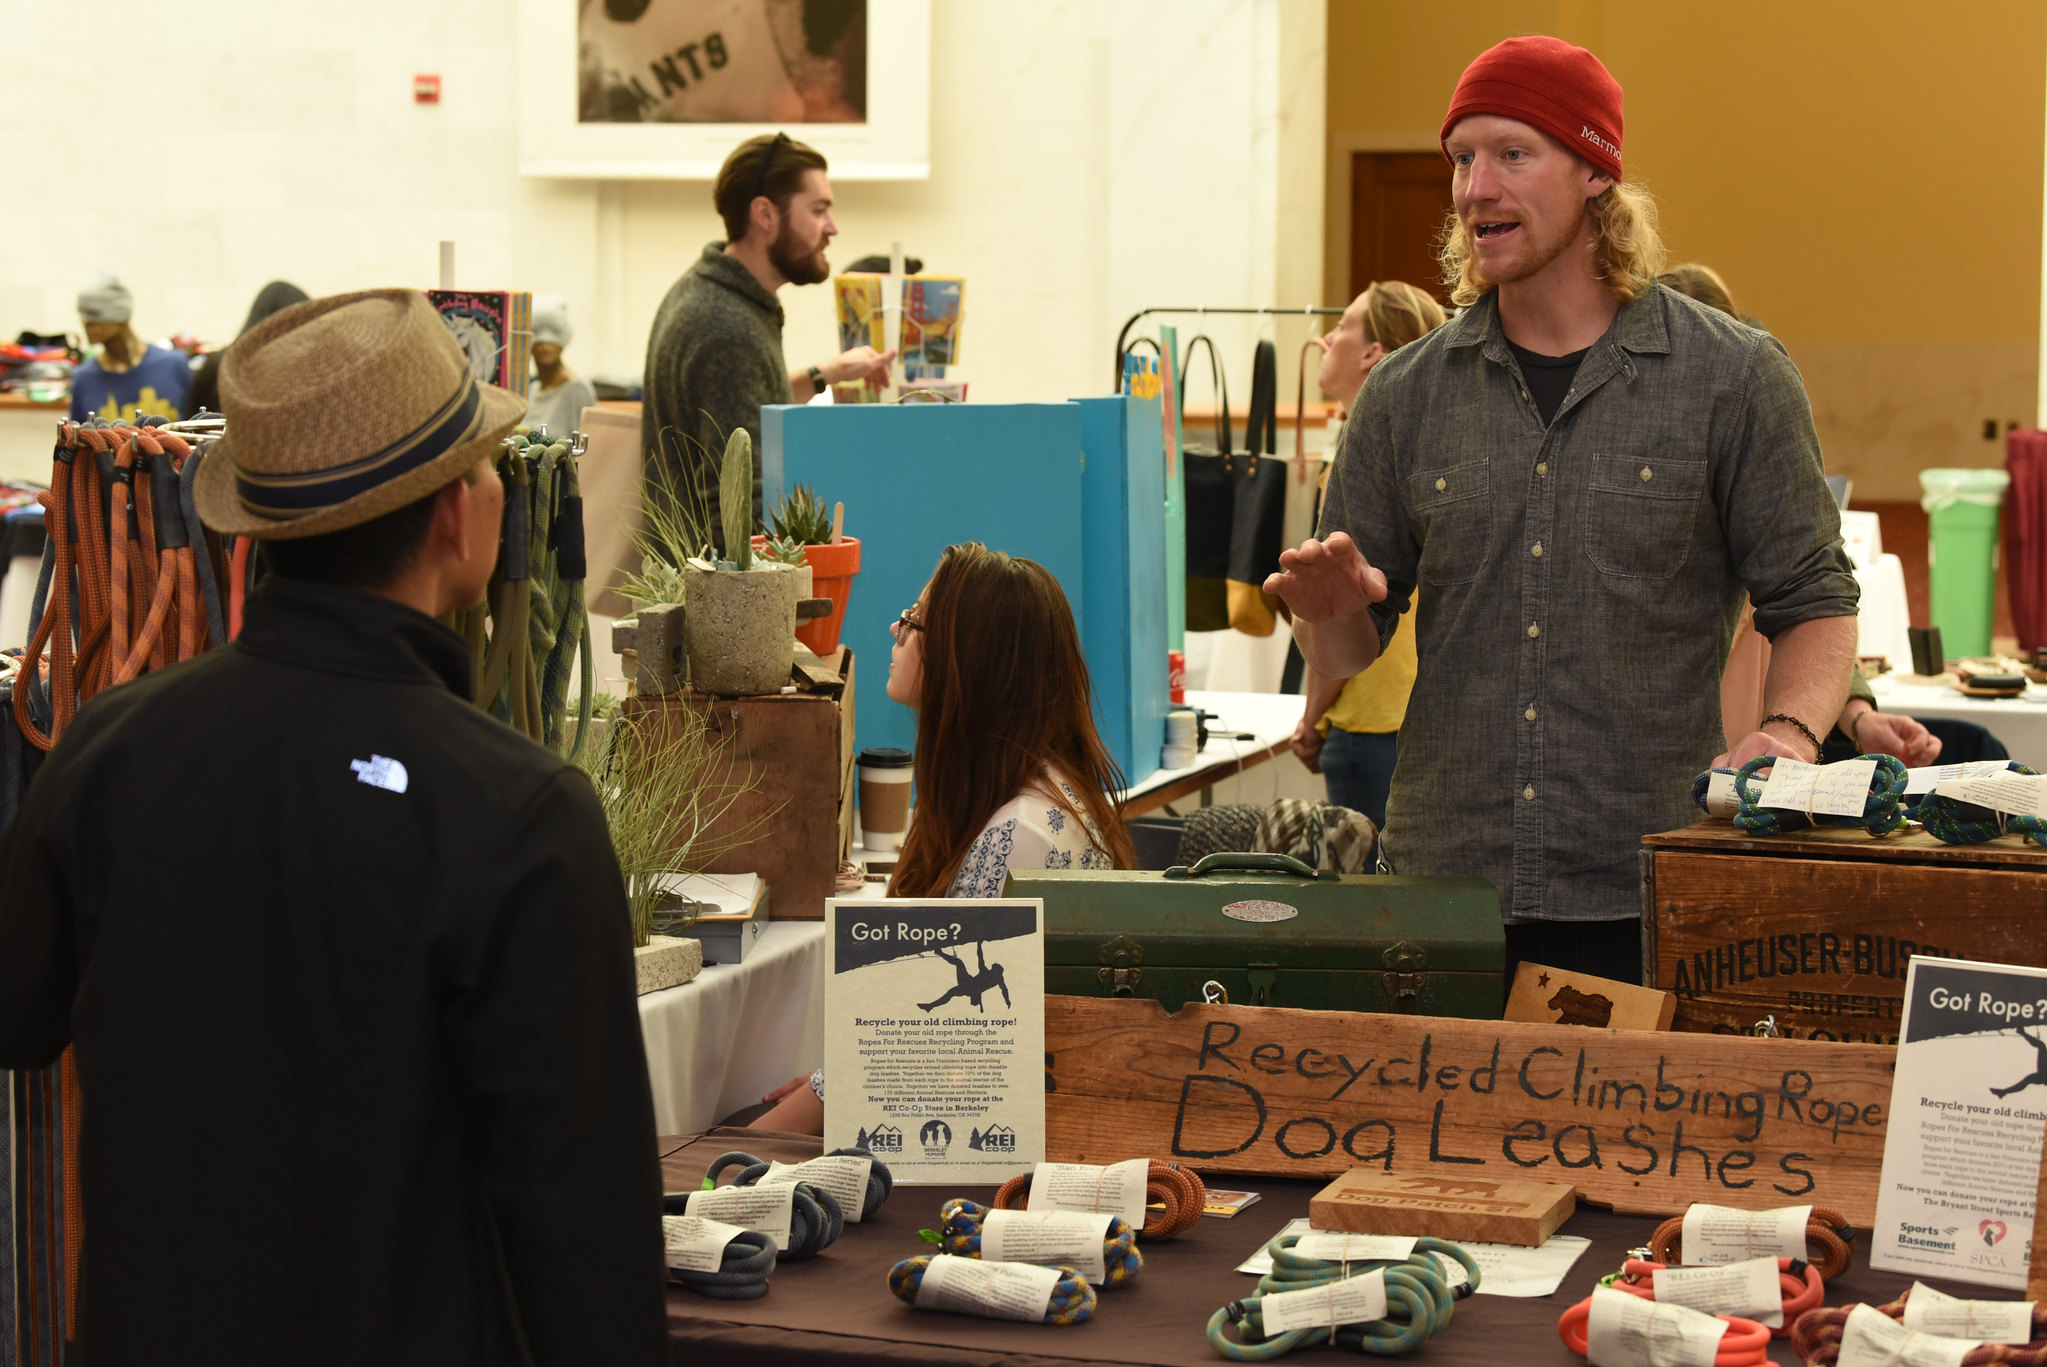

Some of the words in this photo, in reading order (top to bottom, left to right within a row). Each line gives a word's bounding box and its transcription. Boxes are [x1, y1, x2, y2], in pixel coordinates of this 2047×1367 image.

[851, 922, 890, 941] Got
[897, 922, 962, 946] Rope?
[1674, 933, 1963, 1000] ANHEUSER-BUS
[1788, 991, 1904, 1019] PROPERT
[1930, 987, 1971, 1012] Got
[1978, 992, 2047, 1023] Rope?
[855, 1018, 895, 1028] Recycle
[898, 1020, 921, 1028] your
[923, 1018, 939, 1026] old
[942, 1018, 988, 1027] climbing
[990, 1018, 1016, 1027] rope!
[858, 1038, 881, 1046] Ropes
[928, 1038, 965, 1046] Recycling
[966, 1038, 998, 1046] Program
[954, 1029, 984, 1037] through
[1198, 1021, 1500, 1101] Recycled
[1518, 1046, 1765, 1143] Climbing
[1777, 1069, 1882, 1144] Rope
[898, 1105, 922, 1113] Co-Op
[954, 1105, 988, 1113] Berkeley
[1920, 1098, 1964, 1112] Recycle
[1966, 1105, 1991, 1116] your
[1993, 1107, 2012, 1116] old
[1941, 1113, 1969, 1123] Donate
[1970, 1118, 1988, 1127] your
[1990, 1118, 2003, 1127] old
[2006, 1122, 2025, 1132] rope
[873, 1134, 902, 1146] REI
[985, 1134, 1015, 1146] REI
[1921, 1121, 1946, 1132] Ropes
[1948, 1124, 1960, 1132] For
[1962, 1126, 1994, 1137] Rescues
[1996, 1130, 2037, 1144] Recycling
[1429, 1099, 1815, 1196] Leashes
[1920, 1133, 1951, 1144] support
[1954, 1138, 1971, 1146] your
[1973, 1139, 2003, 1150] favorite
[2006, 1143, 2024, 1152] local
[1896, 1183, 1914, 1192] Now
[1916, 1188, 1931, 1196] you
[1950, 1190, 1977, 1200] donate
[1978, 1196, 1998, 1204] your
[1999, 1199, 2018, 1208] rope
[1923, 1197, 1938, 1206] The
[1940, 1200, 1968, 1210] Bryant
[1970, 1204, 1994, 1213] Street
[1995, 1207, 2021, 1218] Sports
[1899, 1222, 1939, 1236] Sports
[1897, 1234, 1956, 1250] Basement
[1969, 1254, 2006, 1268] SPCA
